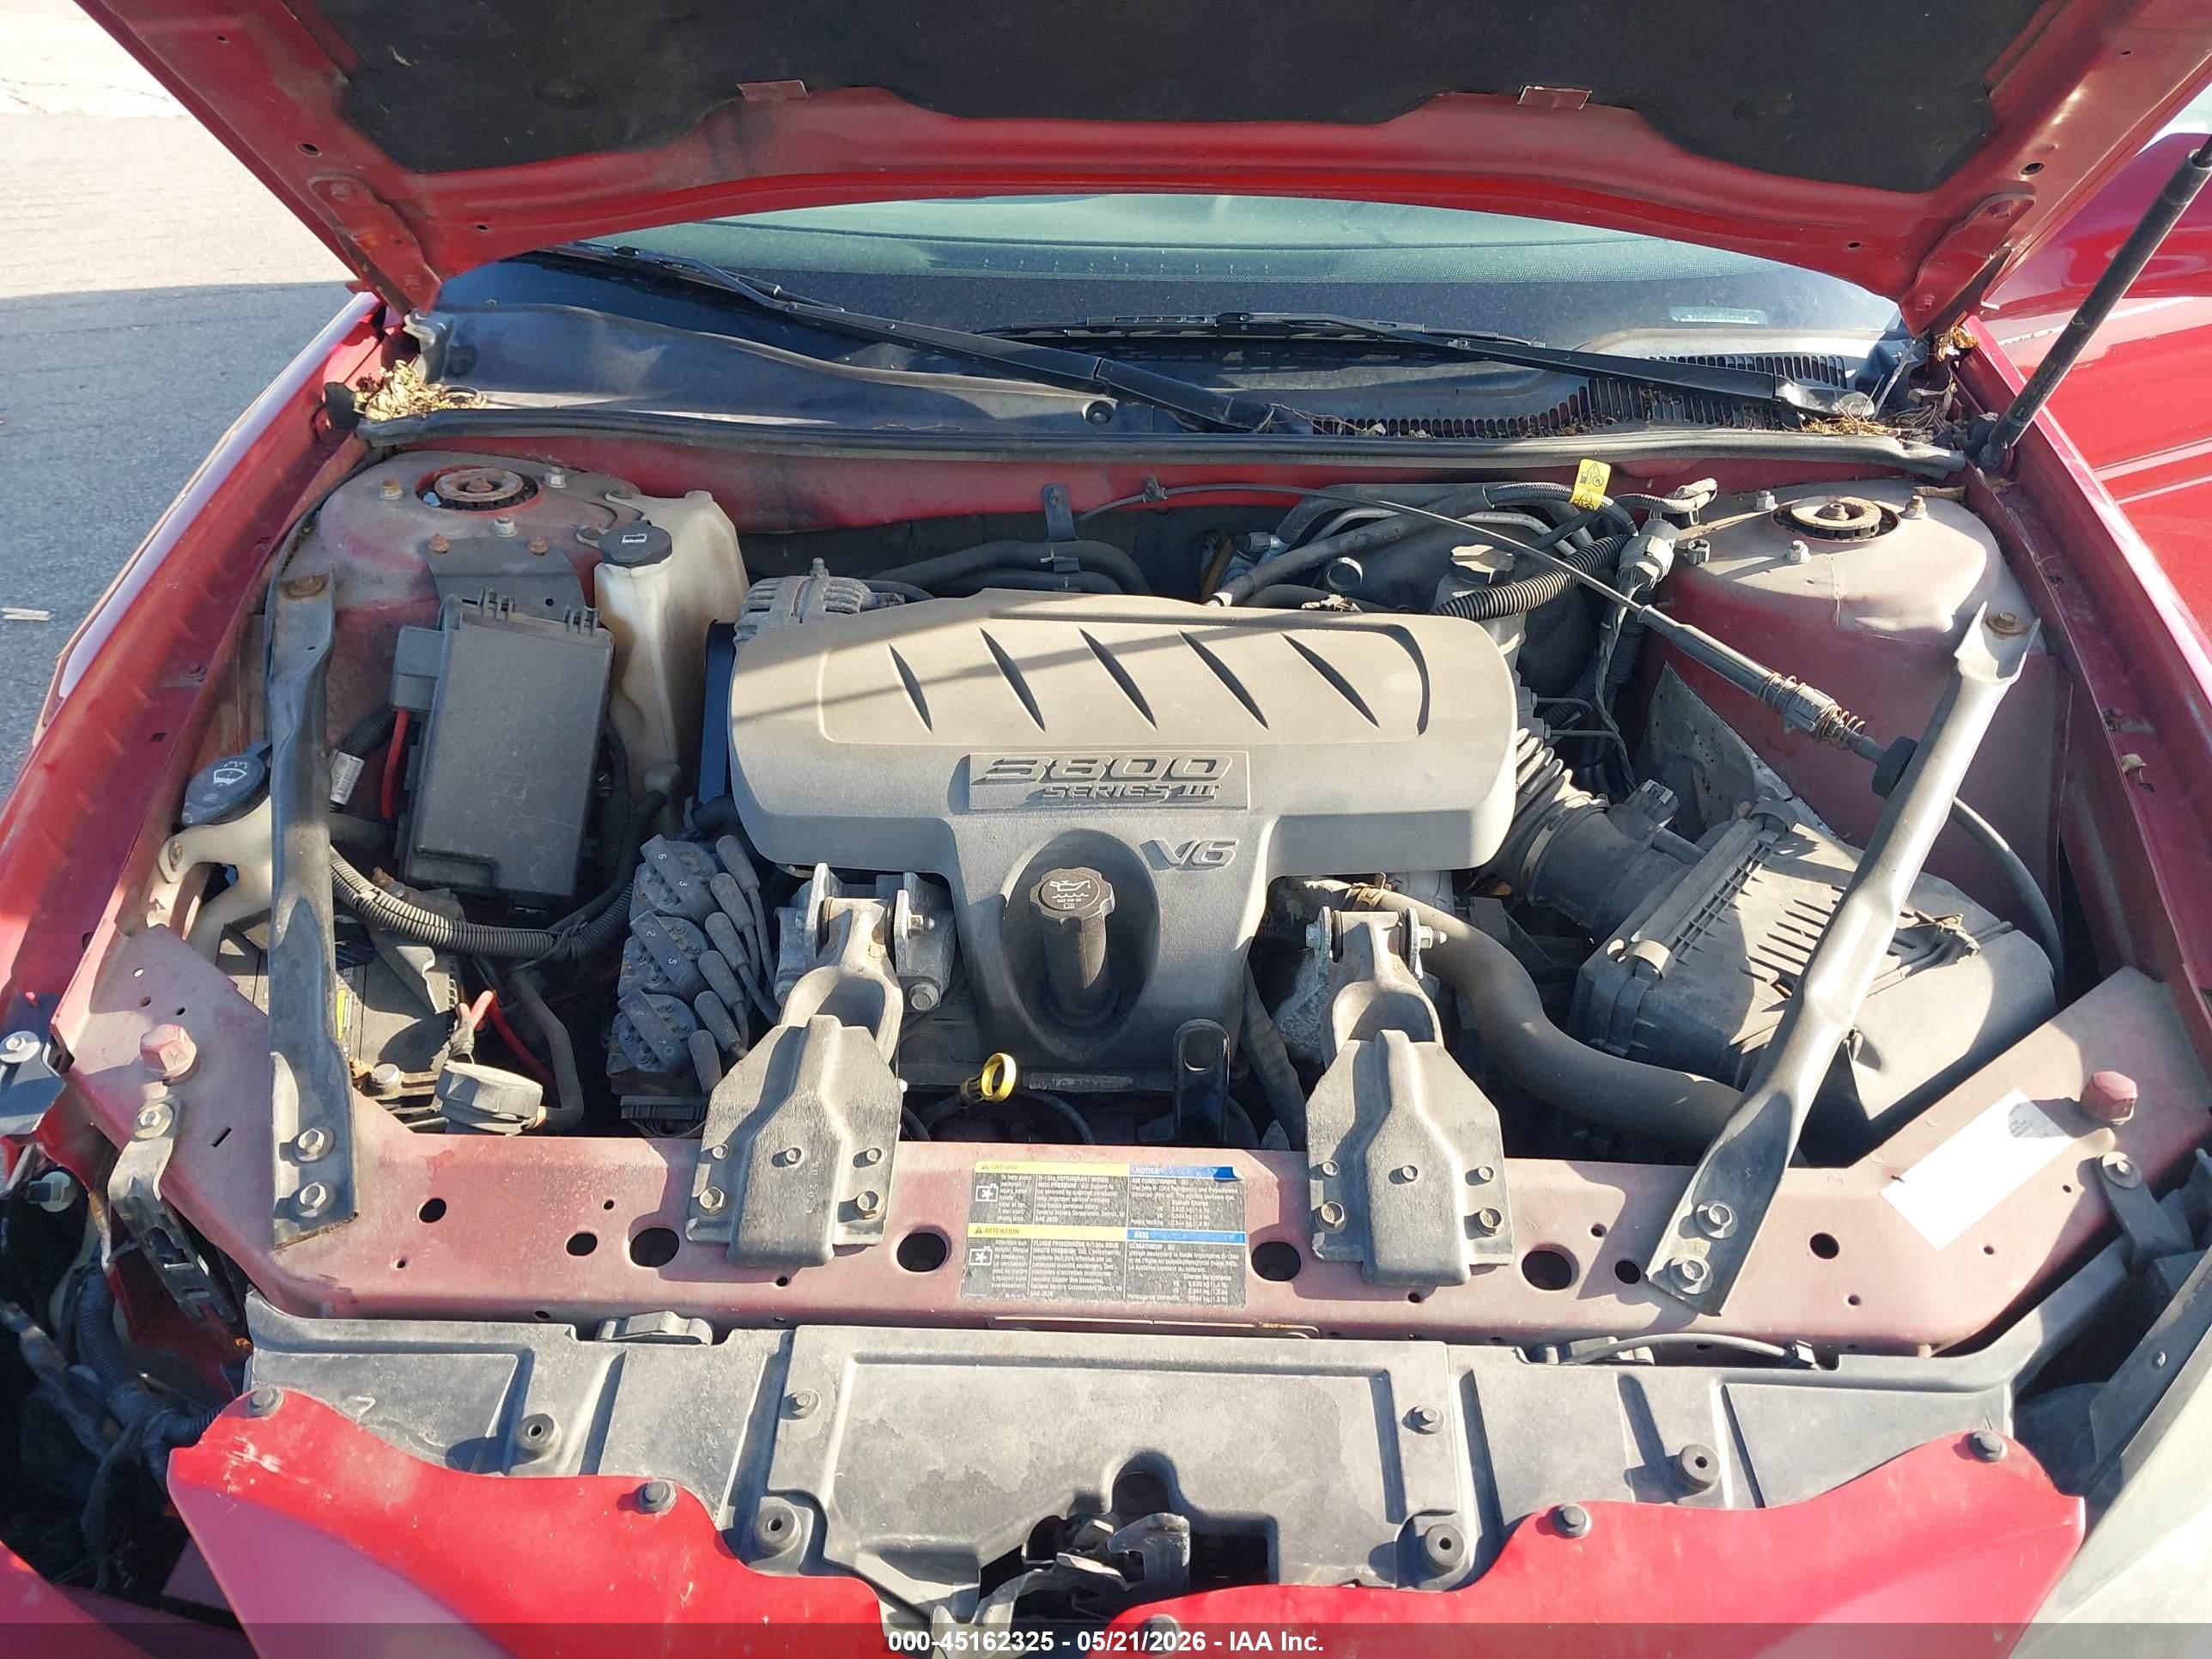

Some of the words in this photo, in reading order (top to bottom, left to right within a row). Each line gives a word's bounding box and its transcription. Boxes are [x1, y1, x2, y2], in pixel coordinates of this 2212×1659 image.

[981, 754, 1234, 782] 3800
[1042, 784, 1173, 800] SERIES
[1177, 785, 1220, 802] III
[1148, 838, 1240, 871] V6
[1133, 1231, 1150, 1239] AVIS
